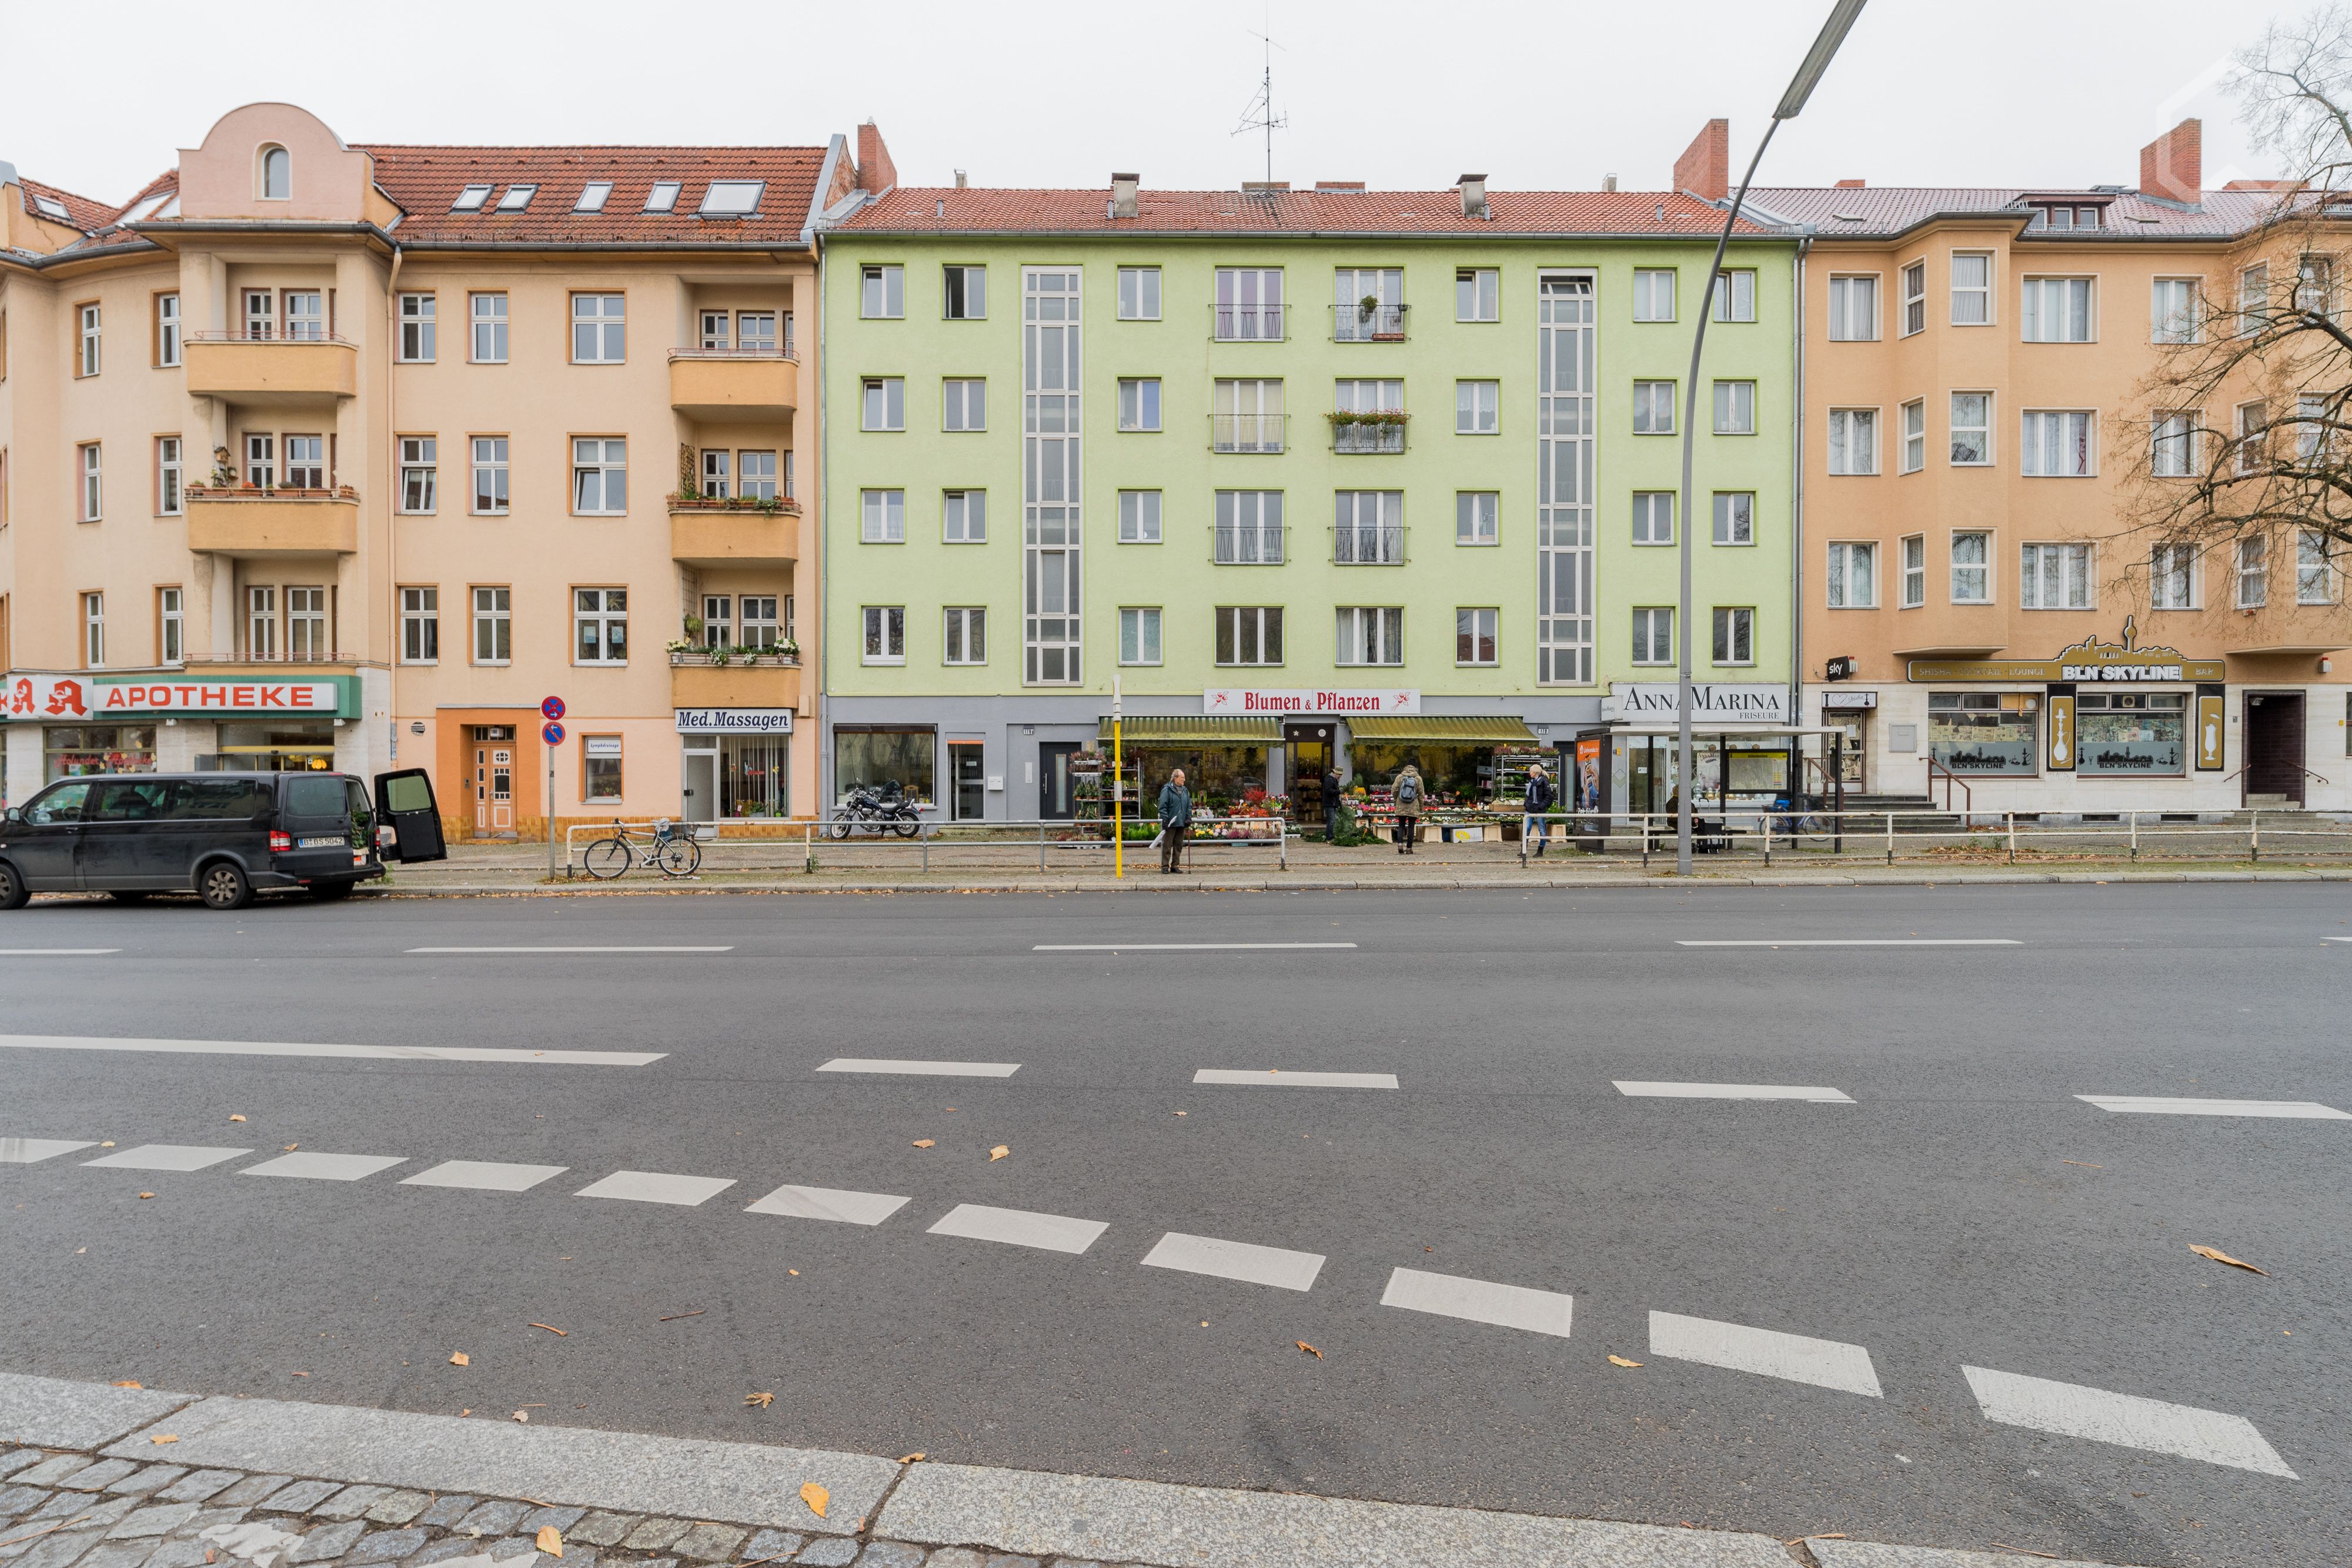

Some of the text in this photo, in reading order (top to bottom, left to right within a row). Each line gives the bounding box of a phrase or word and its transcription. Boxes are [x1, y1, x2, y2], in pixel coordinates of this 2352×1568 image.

[1829, 662, 1843, 675] sky
[1959, 668, 2002, 676] COCKTAIL
[2009, 667, 2046, 676] LOUNGE
[2062, 665, 2180, 680] BLN SKYLINE
[2195, 667, 2214, 676] BAR
[106, 686, 313, 707] APOTHEKE
[1244, 691, 1380, 711] Blumen & Pflanzen
[1690, 686, 1780, 710] MARINA
[55, 754, 99, 769] Holunder
